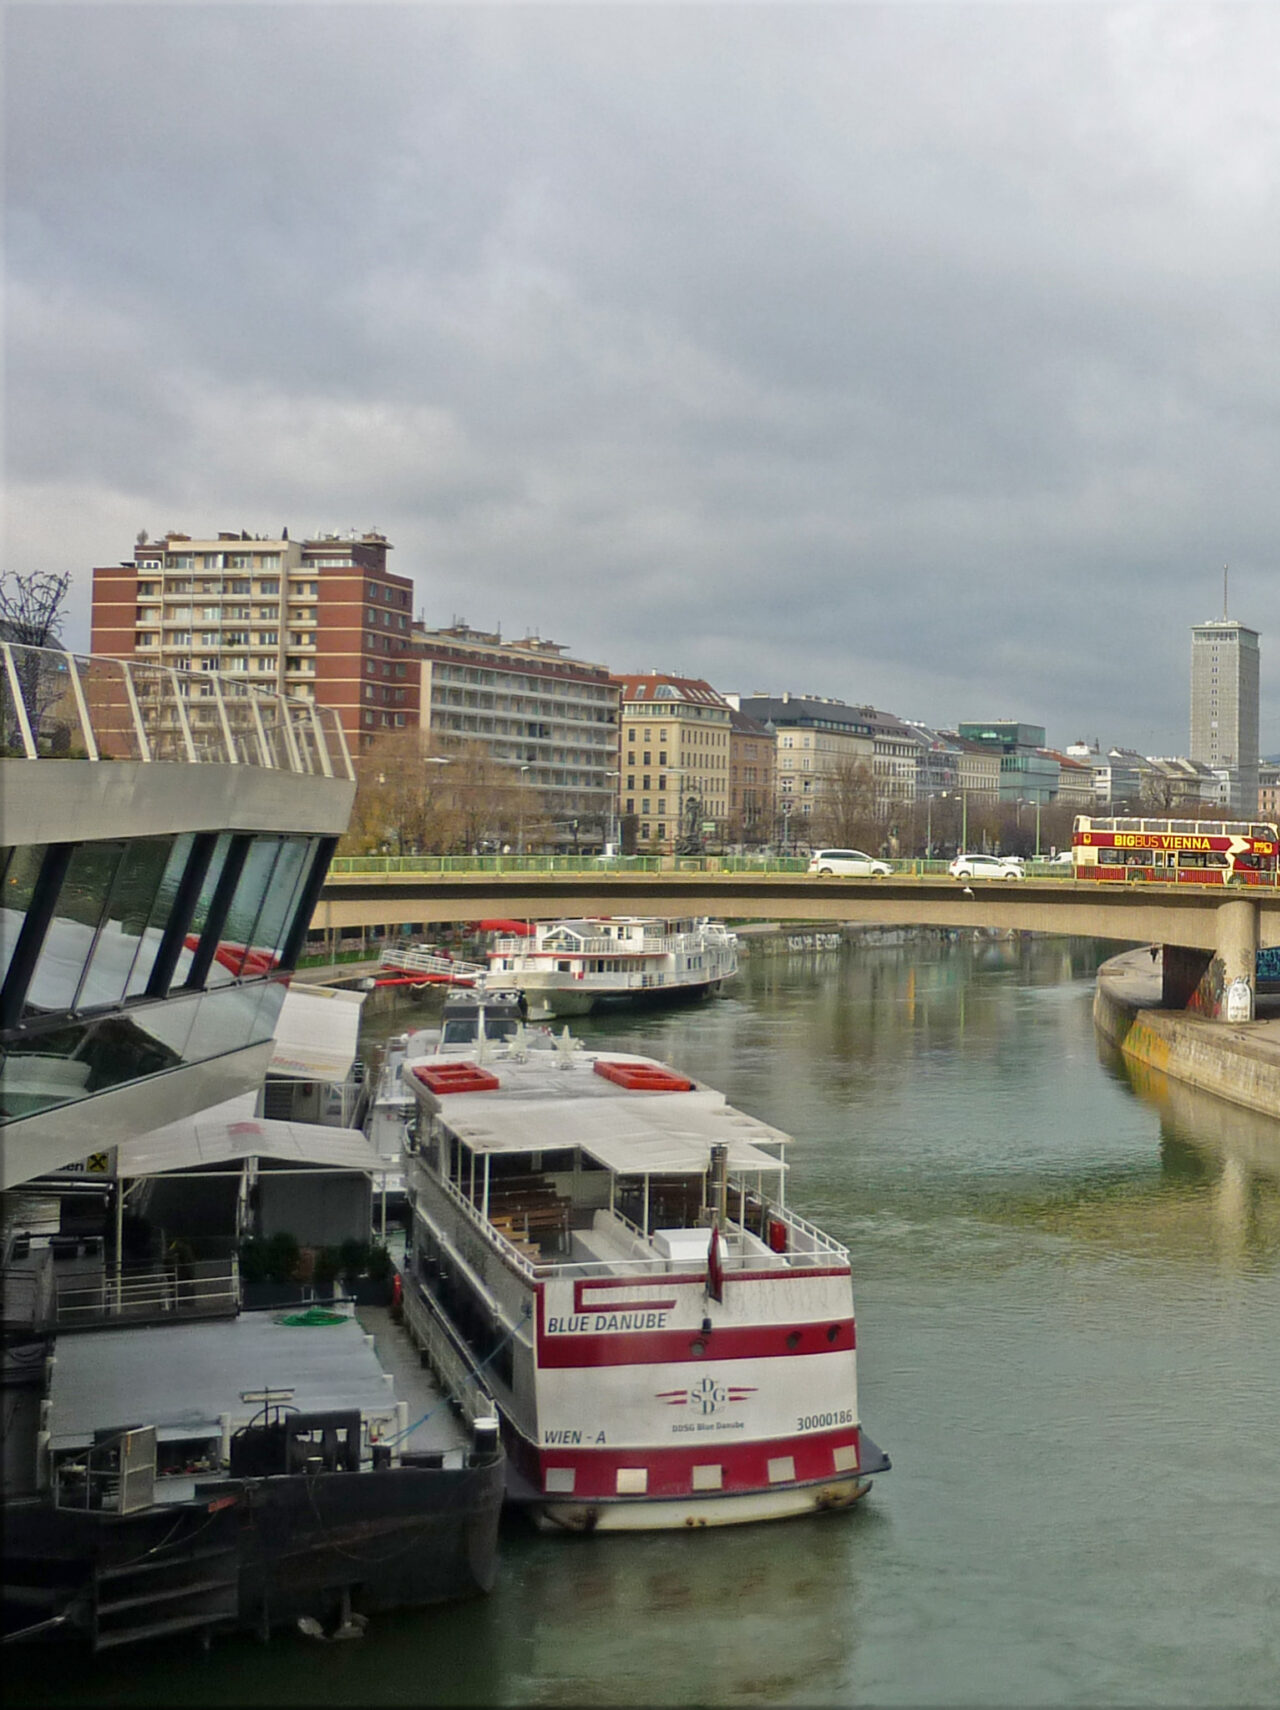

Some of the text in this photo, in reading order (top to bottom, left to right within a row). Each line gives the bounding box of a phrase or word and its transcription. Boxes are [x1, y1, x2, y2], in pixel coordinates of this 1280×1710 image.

[1162, 836, 1211, 849] VIENNA
[548, 1313, 667, 1333] BLUE DANUBE
[672, 1421, 744, 1433] DDSG Blue Danube
[797, 1409, 853, 1431] 30000186
[544, 1430, 582, 1444] WIEN
[595, 1430, 607, 1444] A
